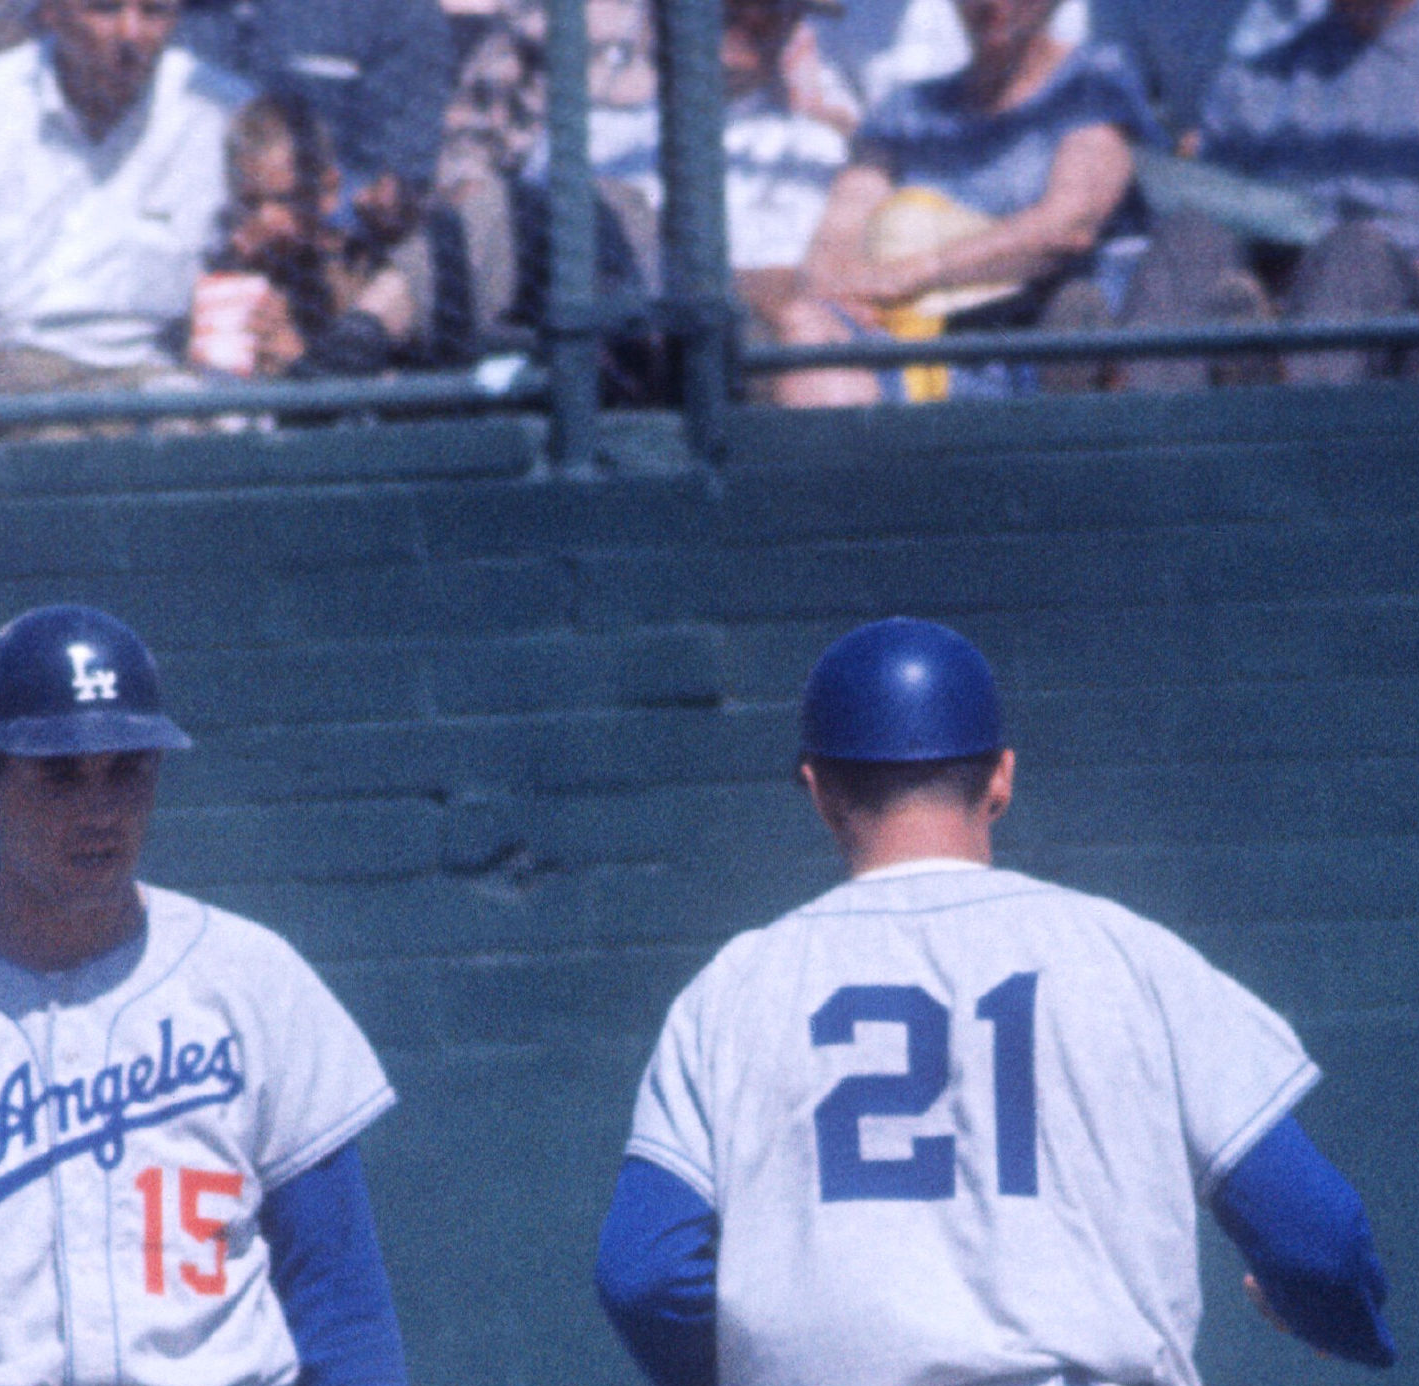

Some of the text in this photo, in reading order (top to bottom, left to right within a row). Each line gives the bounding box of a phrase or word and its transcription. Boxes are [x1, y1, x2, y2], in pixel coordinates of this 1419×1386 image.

[66, 642, 118, 701] LA
[808, 970, 1040, 1203] 21
[135, 1165, 245, 1297] 15
